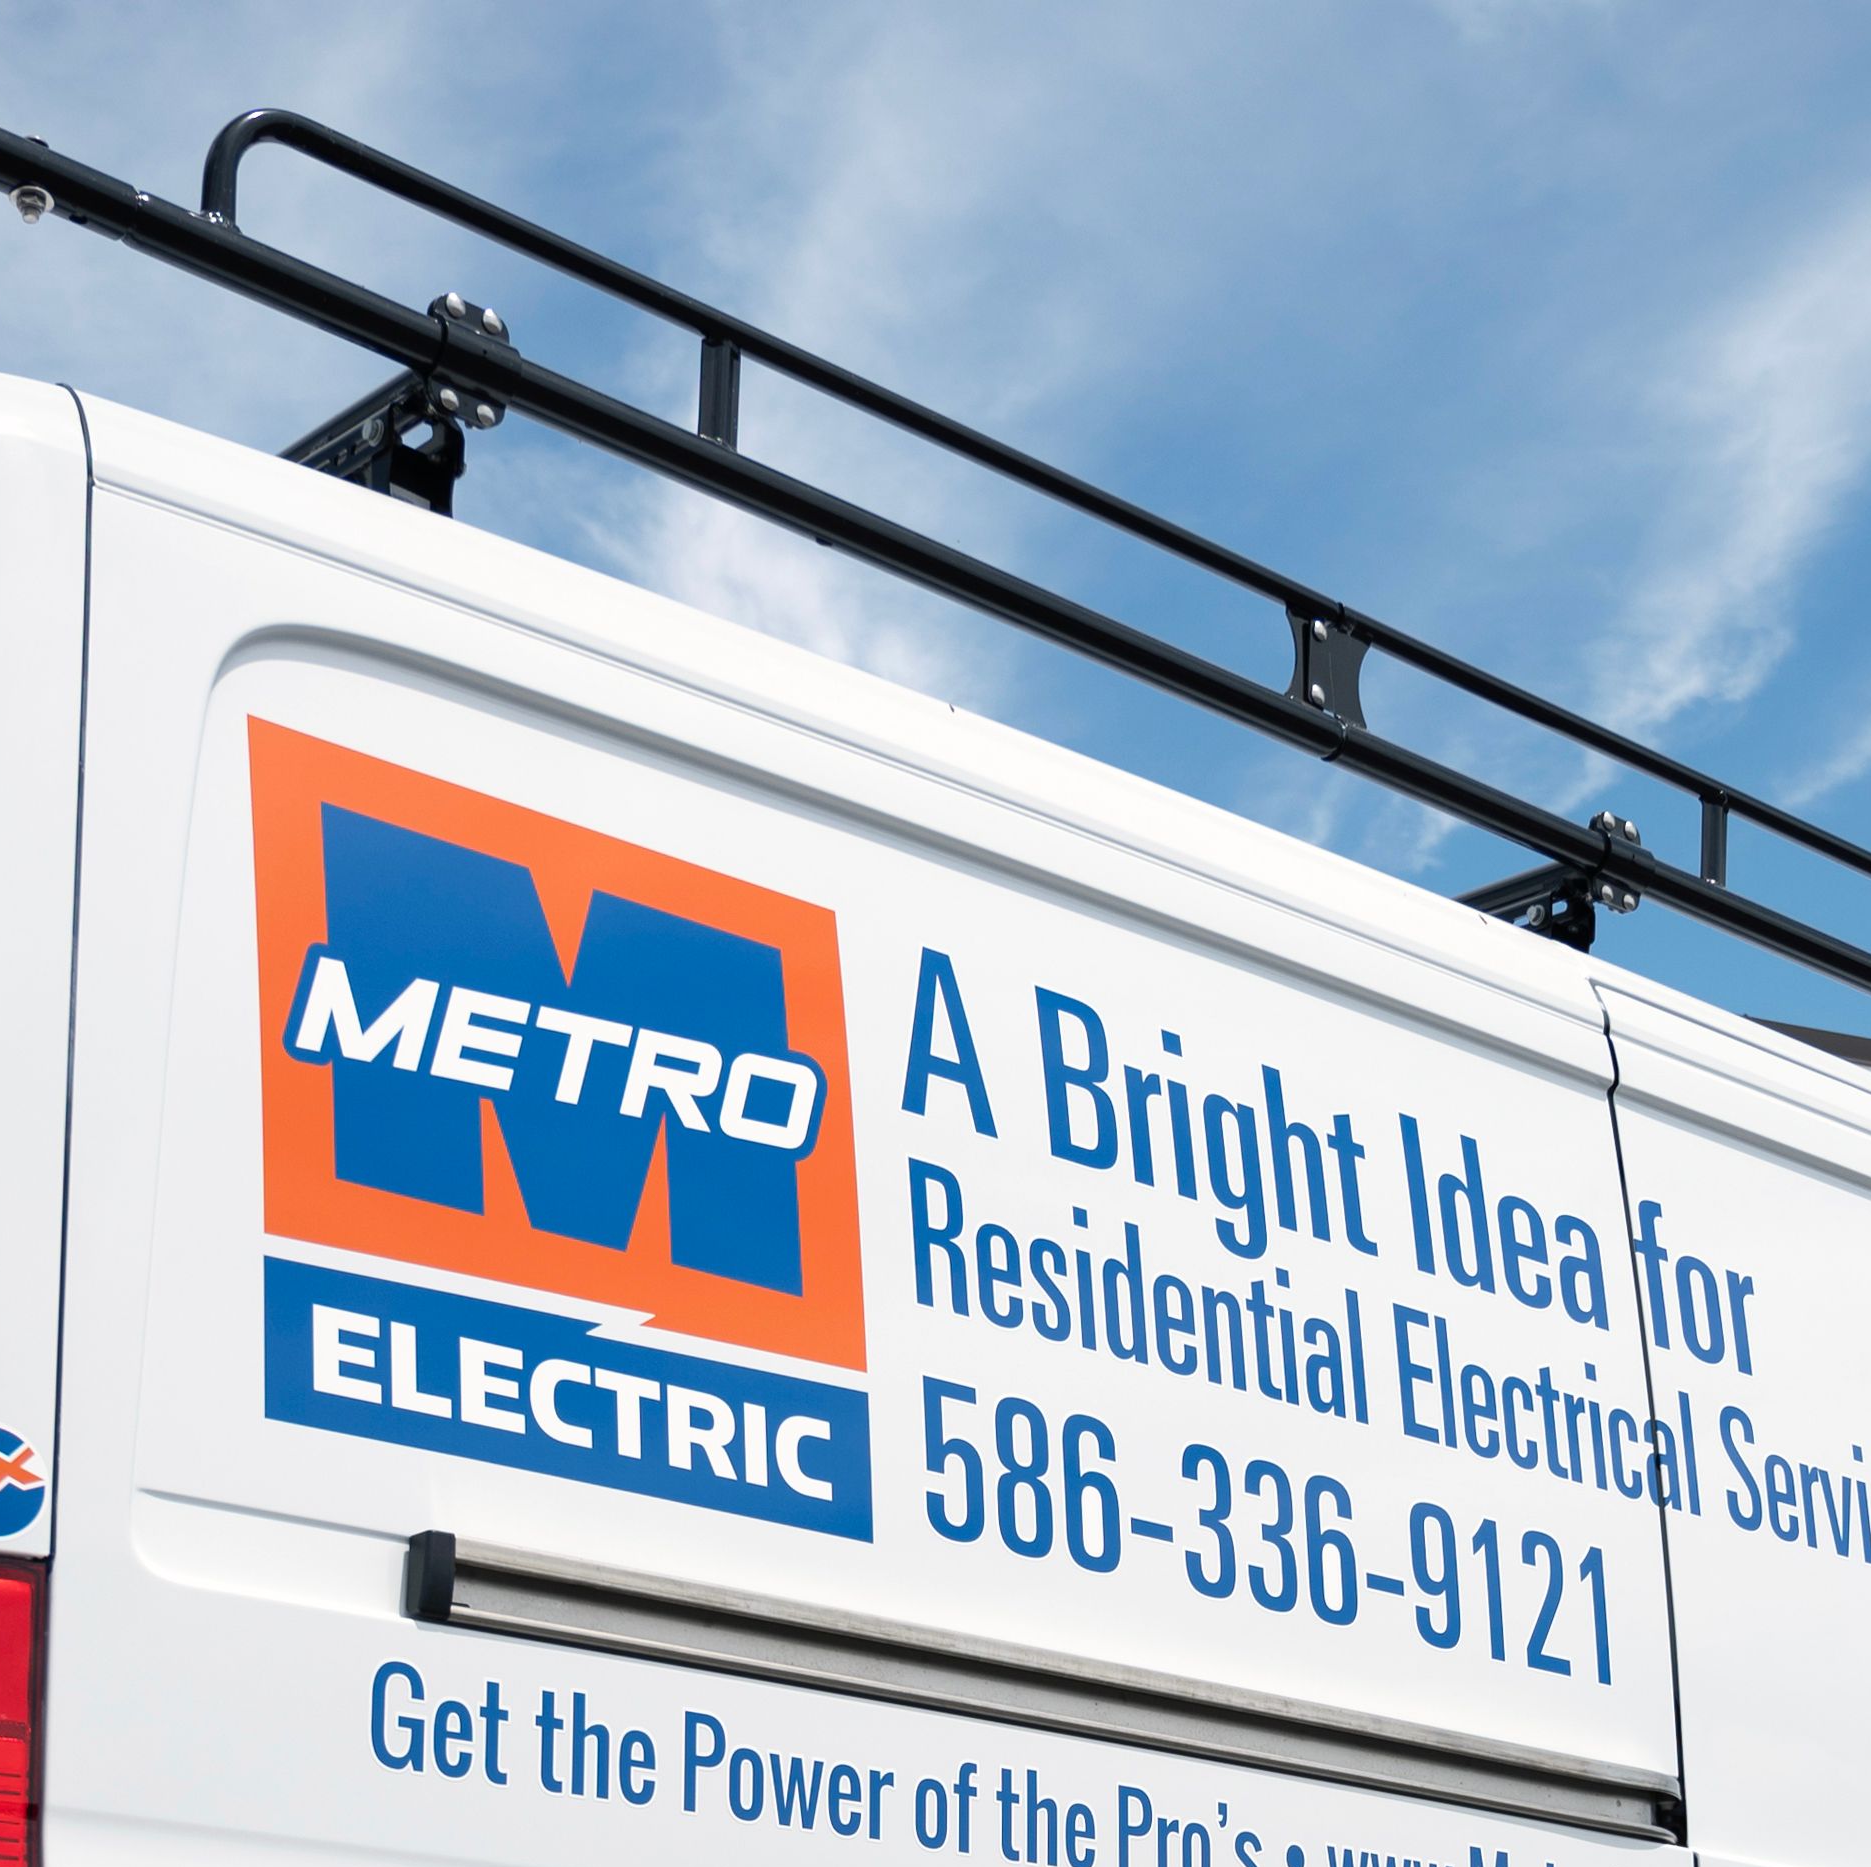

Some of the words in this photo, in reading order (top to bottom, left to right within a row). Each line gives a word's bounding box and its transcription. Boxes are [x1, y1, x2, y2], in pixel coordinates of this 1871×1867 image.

[295, 957, 818, 1150] METRO
[901, 946, 999, 1138] A
[1034, 986, 1377, 1260] Bright
[1398, 1113, 1610, 1331] Idea
[1633, 1199, 1754, 1378] for
[312, 1304, 833, 1502] ELECTRIC
[908, 1156, 1370, 1424] Residential
[1392, 1303, 1702, 1517] Electrical
[923, 1375, 1612, 1686] 586-336-9121
[370, 1661, 507, 1786] Get
[535, 1691, 656, 1806] the
[684, 1710, 894, 1840] Power
[914, 1762, 979, 1852] of
